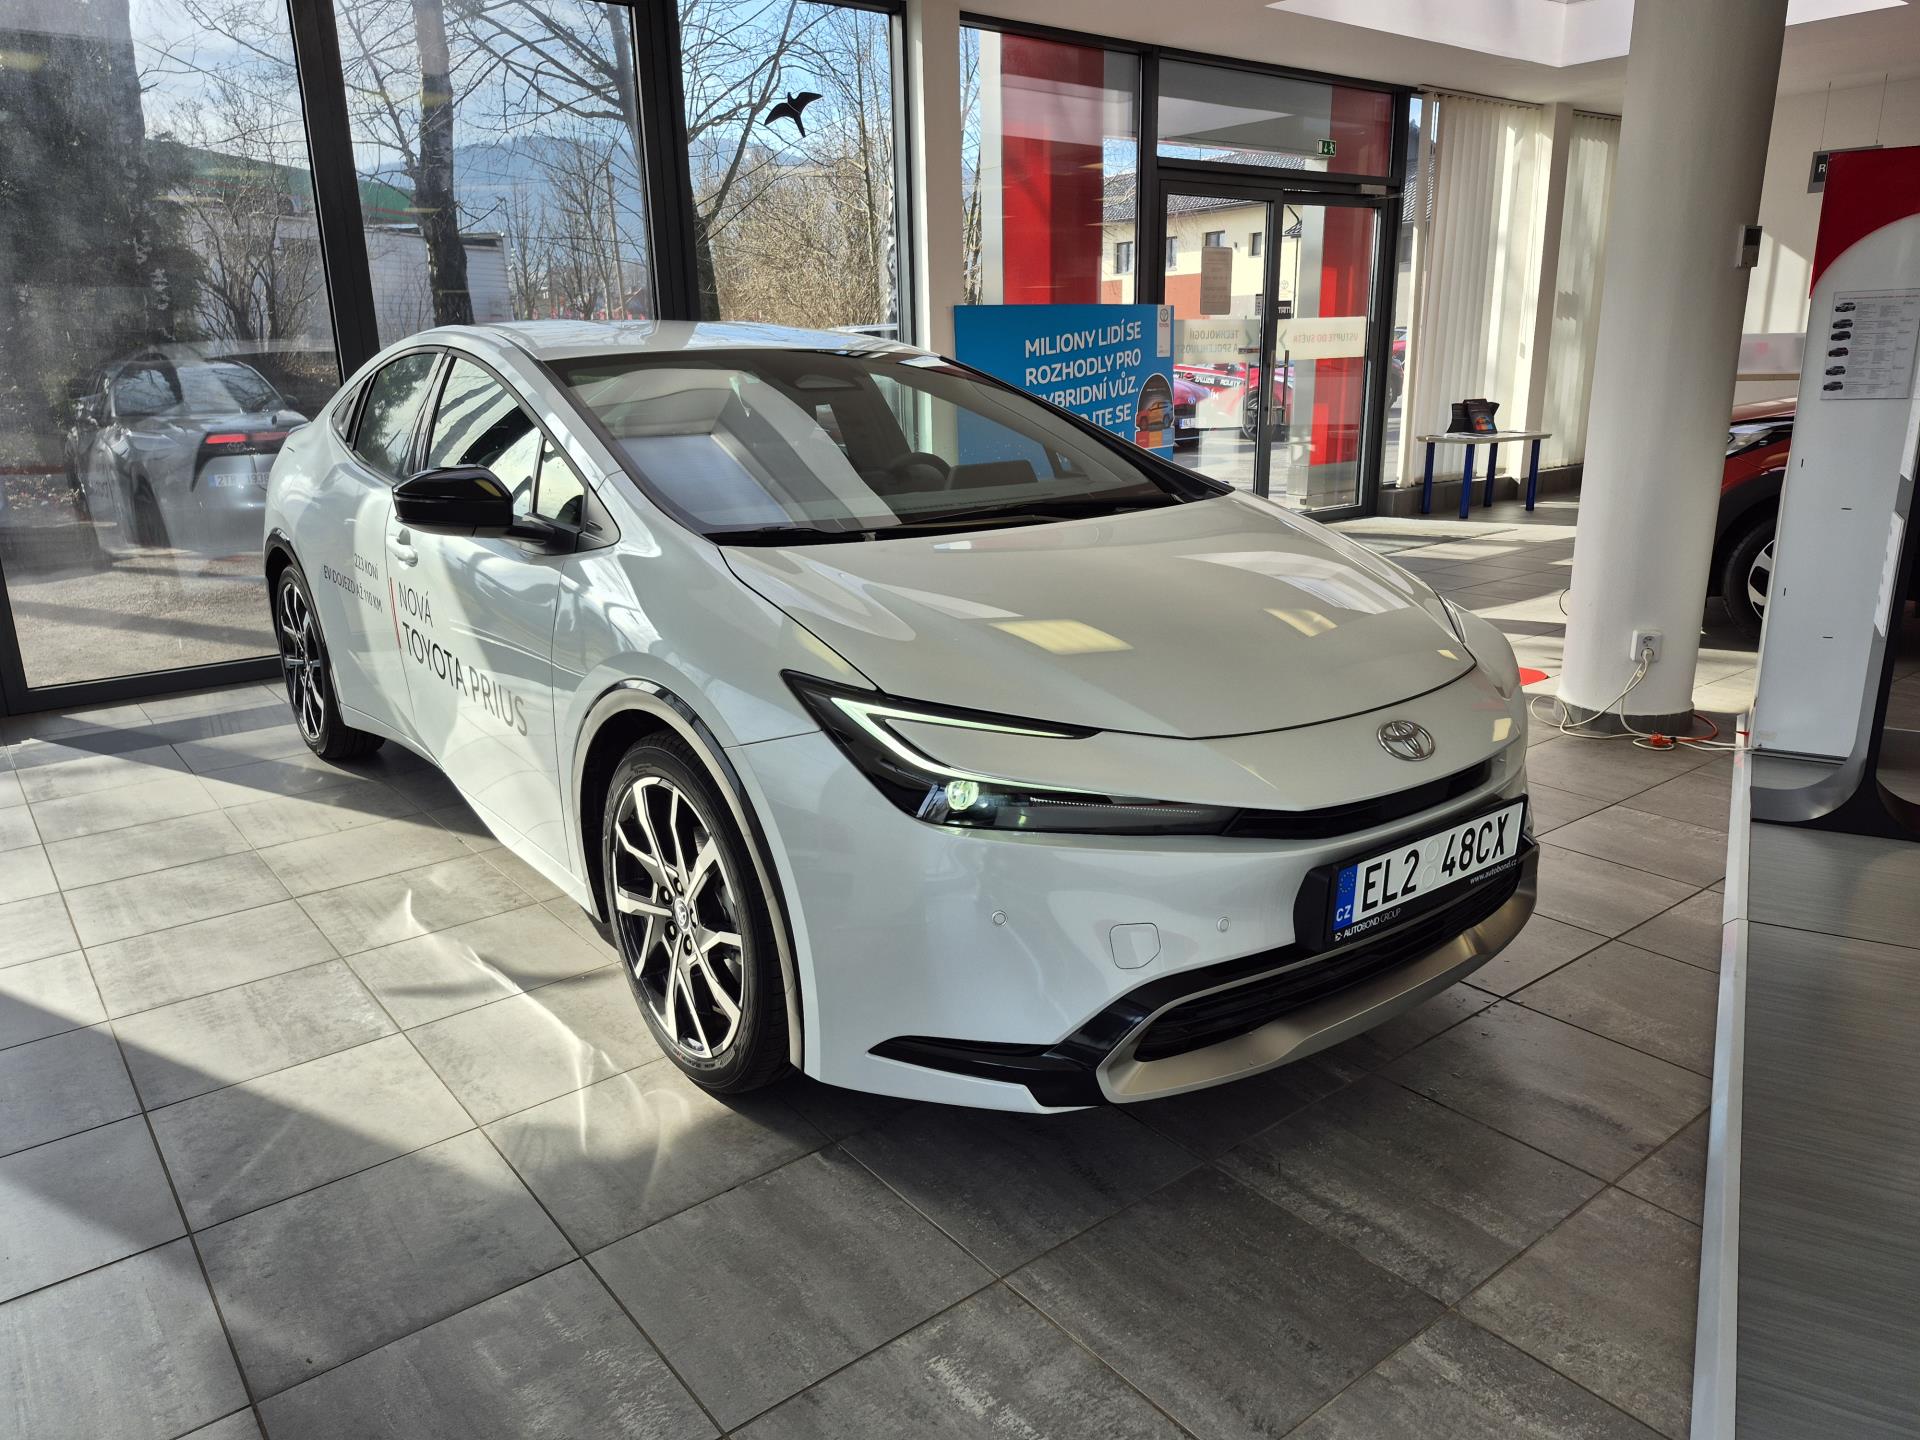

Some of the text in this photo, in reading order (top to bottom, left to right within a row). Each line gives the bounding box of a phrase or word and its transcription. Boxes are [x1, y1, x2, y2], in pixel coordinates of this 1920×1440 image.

[1025, 318, 1142, 358] MILIONY LIDÍ SE
[1025, 348, 1141, 386] ROZHODLY PRO
[1109, 372, 1138, 398] VŮZ.
[1115, 402, 1132, 423] SE
[324, 564, 331, 580] EV
[332, 568, 356, 593] DOJEZD
[365, 558, 378, 581] KONÍ
[398, 581, 433, 628] NOVÁ
[402, 622, 528, 736] TOYOTA PRIUS
[1362, 812, 1510, 913] EL2 48CX
[1336, 904, 1351, 922] CZ
[1344, 908, 1401, 938] AUTOBOND GROUP
